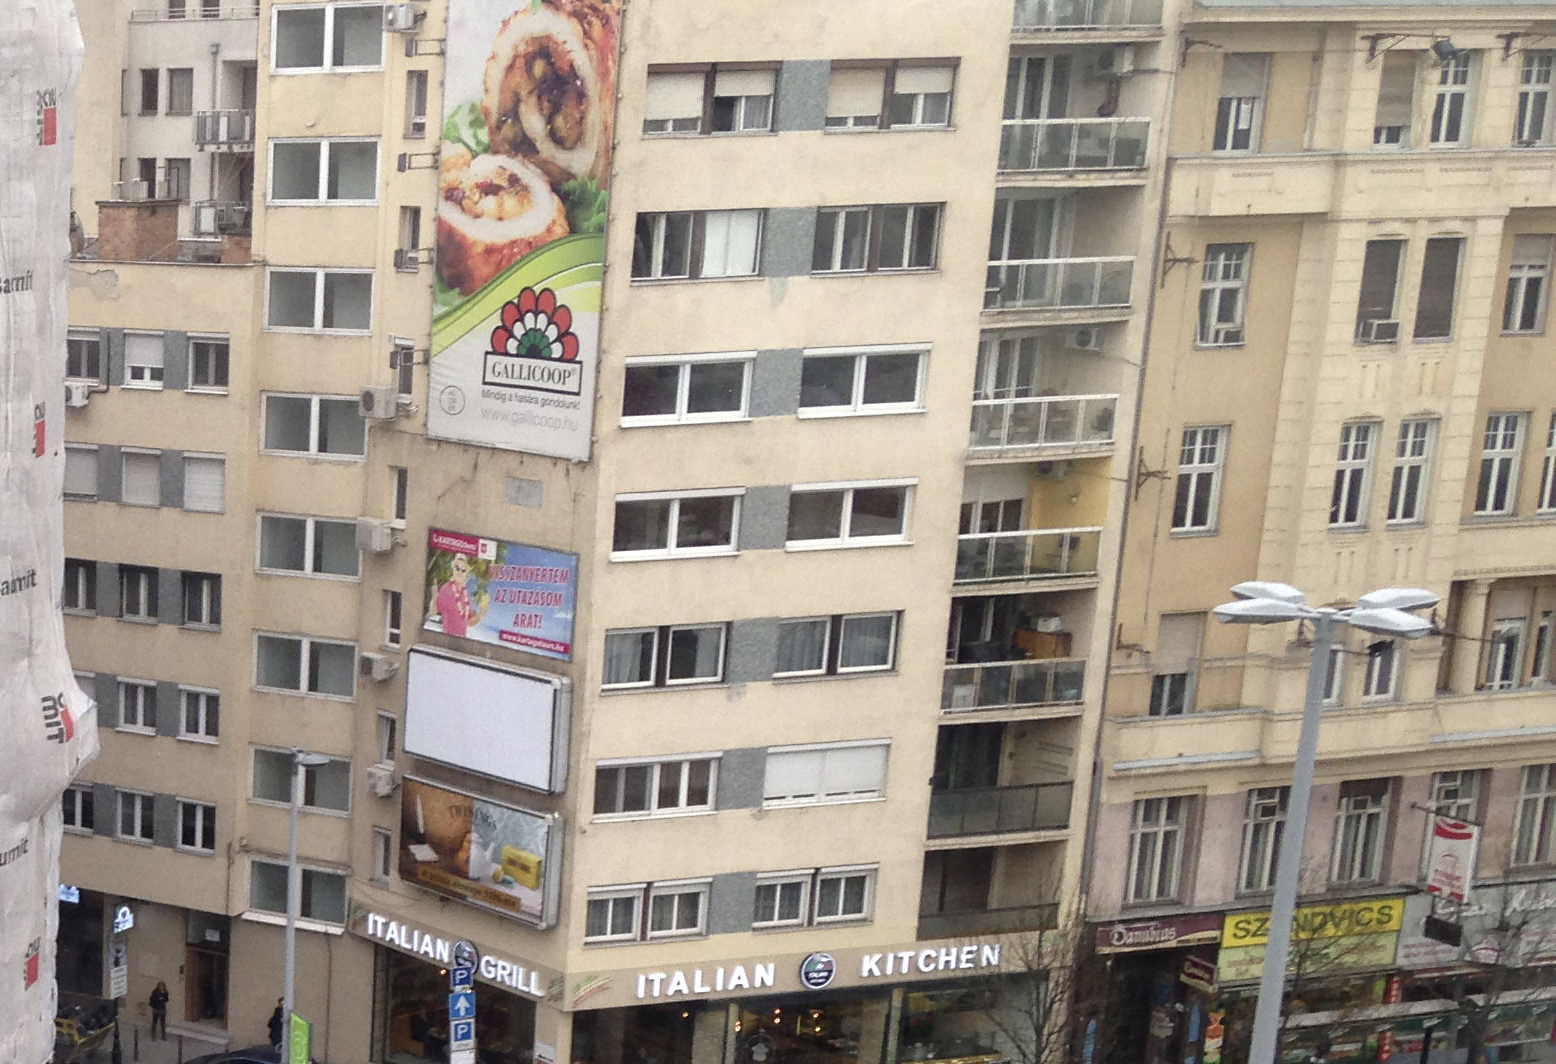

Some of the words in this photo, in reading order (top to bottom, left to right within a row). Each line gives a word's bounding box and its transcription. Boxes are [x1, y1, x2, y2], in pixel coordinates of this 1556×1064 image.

[492, 361, 572, 386] GALLICOOP
[481, 407, 579, 432] www.gallicoop.hu
[1233, 904, 1394, 940] SZNDVICS
[368, 913, 449, 963] ITALIAN
[480, 955, 544, 997] GRILL
[455, 970, 467, 984] P
[637, 963, 775, 998] ITALIAN
[861, 944, 1002, 978] KITCHEN
[457, 1024, 468, 1040] P
